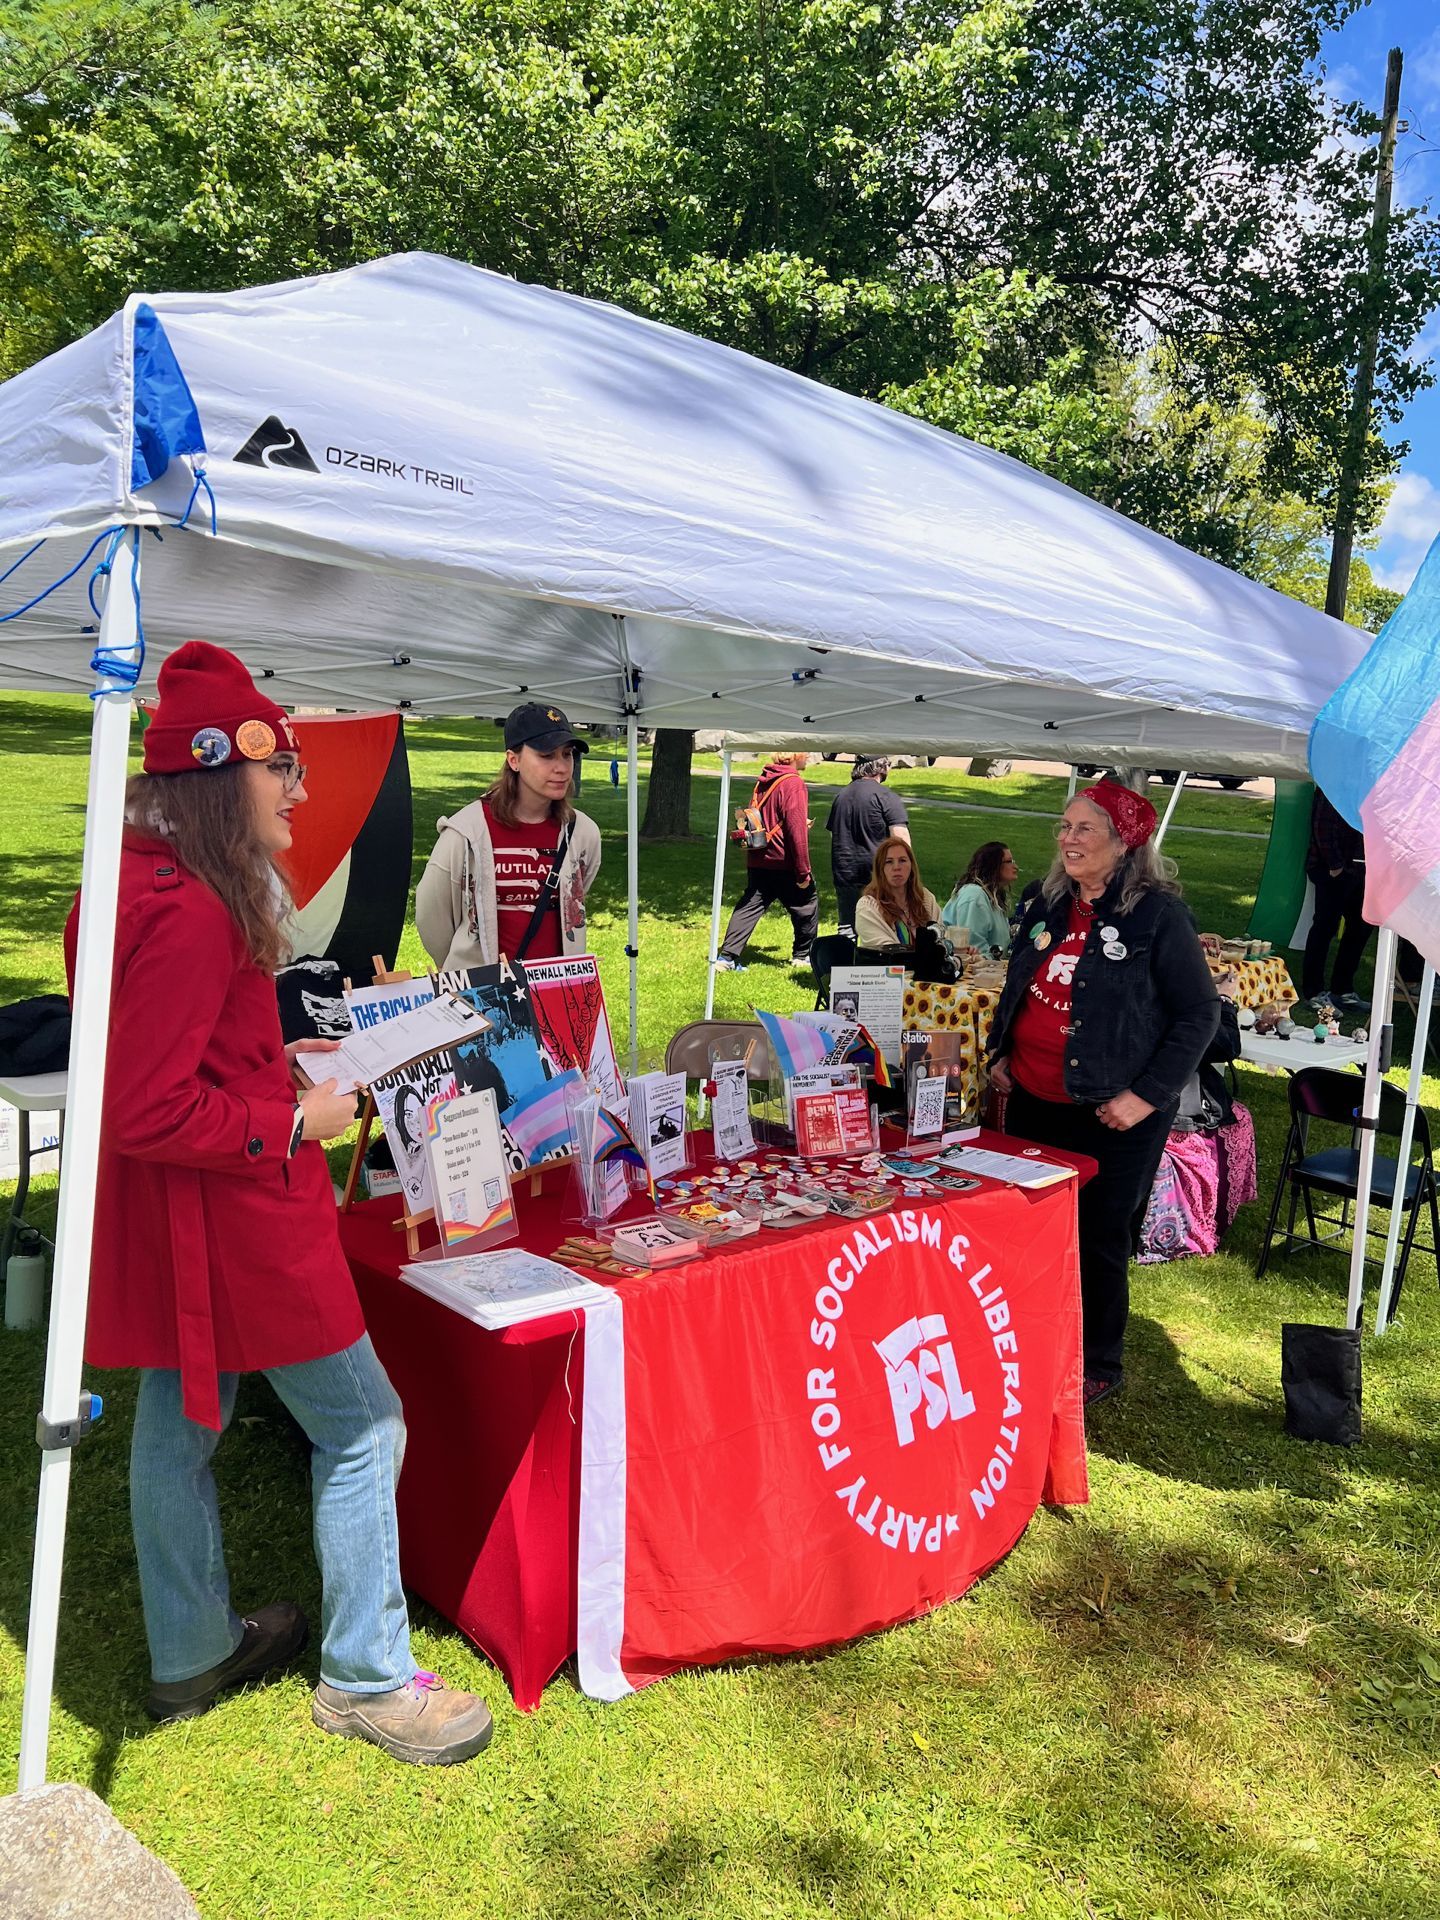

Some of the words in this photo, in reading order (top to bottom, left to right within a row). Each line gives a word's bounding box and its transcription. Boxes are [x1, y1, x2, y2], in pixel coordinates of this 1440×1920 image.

[495, 863, 553, 874] MUTILAT
[505, 894, 540, 902] SALV
[527, 966, 564, 982] NEWALL
[564, 962, 594, 977] MEANS
[1046, 953, 1080, 985] PS
[351, 1002, 380, 1031] THE
[380, 996, 411, 1022] RICH
[831, 1029, 858, 1066] BERATION
[902, 1032, 932, 1043] Station
[948, 1234, 971, 1273] &
[810, 1209, 942, 1351] SOCIALISM
[884, 1340, 977, 1448] PSL
[967, 1263, 1023, 1521] LIBERATION
[807, 1366, 852, 1472] FOR
[835, 1475, 941, 1553] PARTY
